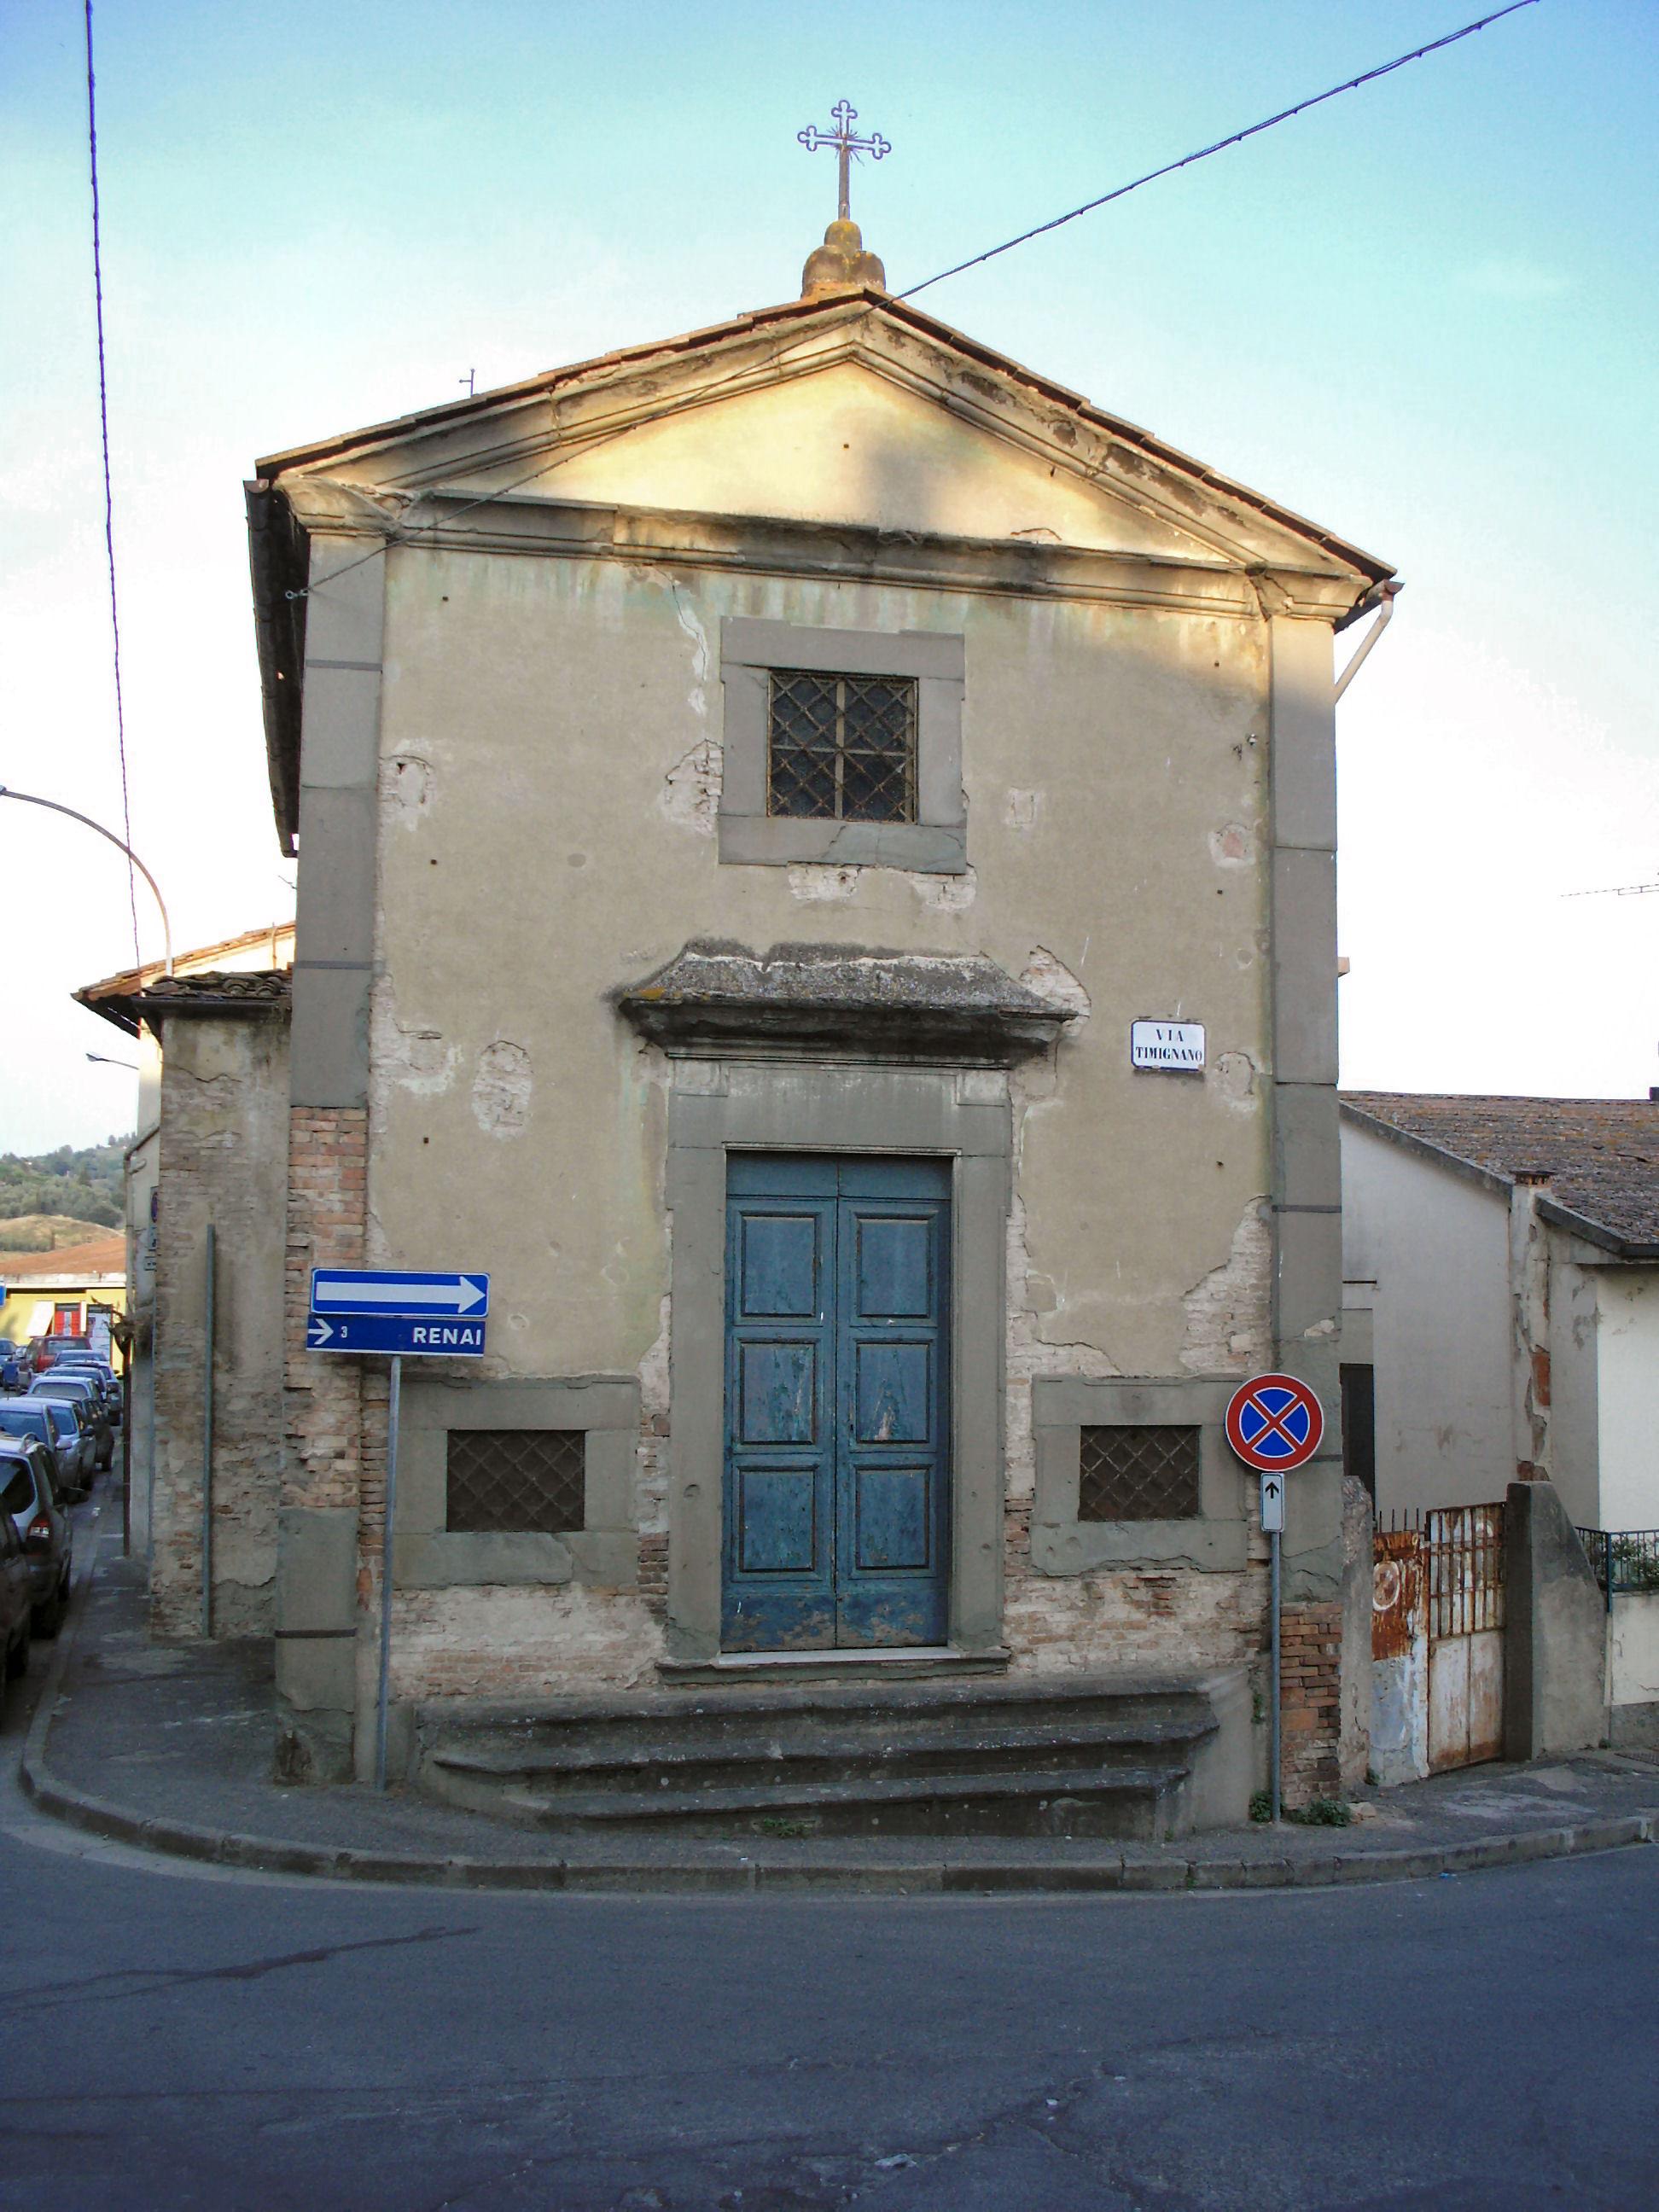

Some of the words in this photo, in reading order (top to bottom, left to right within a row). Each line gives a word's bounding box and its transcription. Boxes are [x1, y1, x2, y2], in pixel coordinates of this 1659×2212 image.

[1155, 1029, 1184, 1041] VIA
[1135, 1046, 1202, 1062] TIMIGNANO
[341, 1325, 348, 1338] 3
[413, 1327, 481, 1346] RENAI
